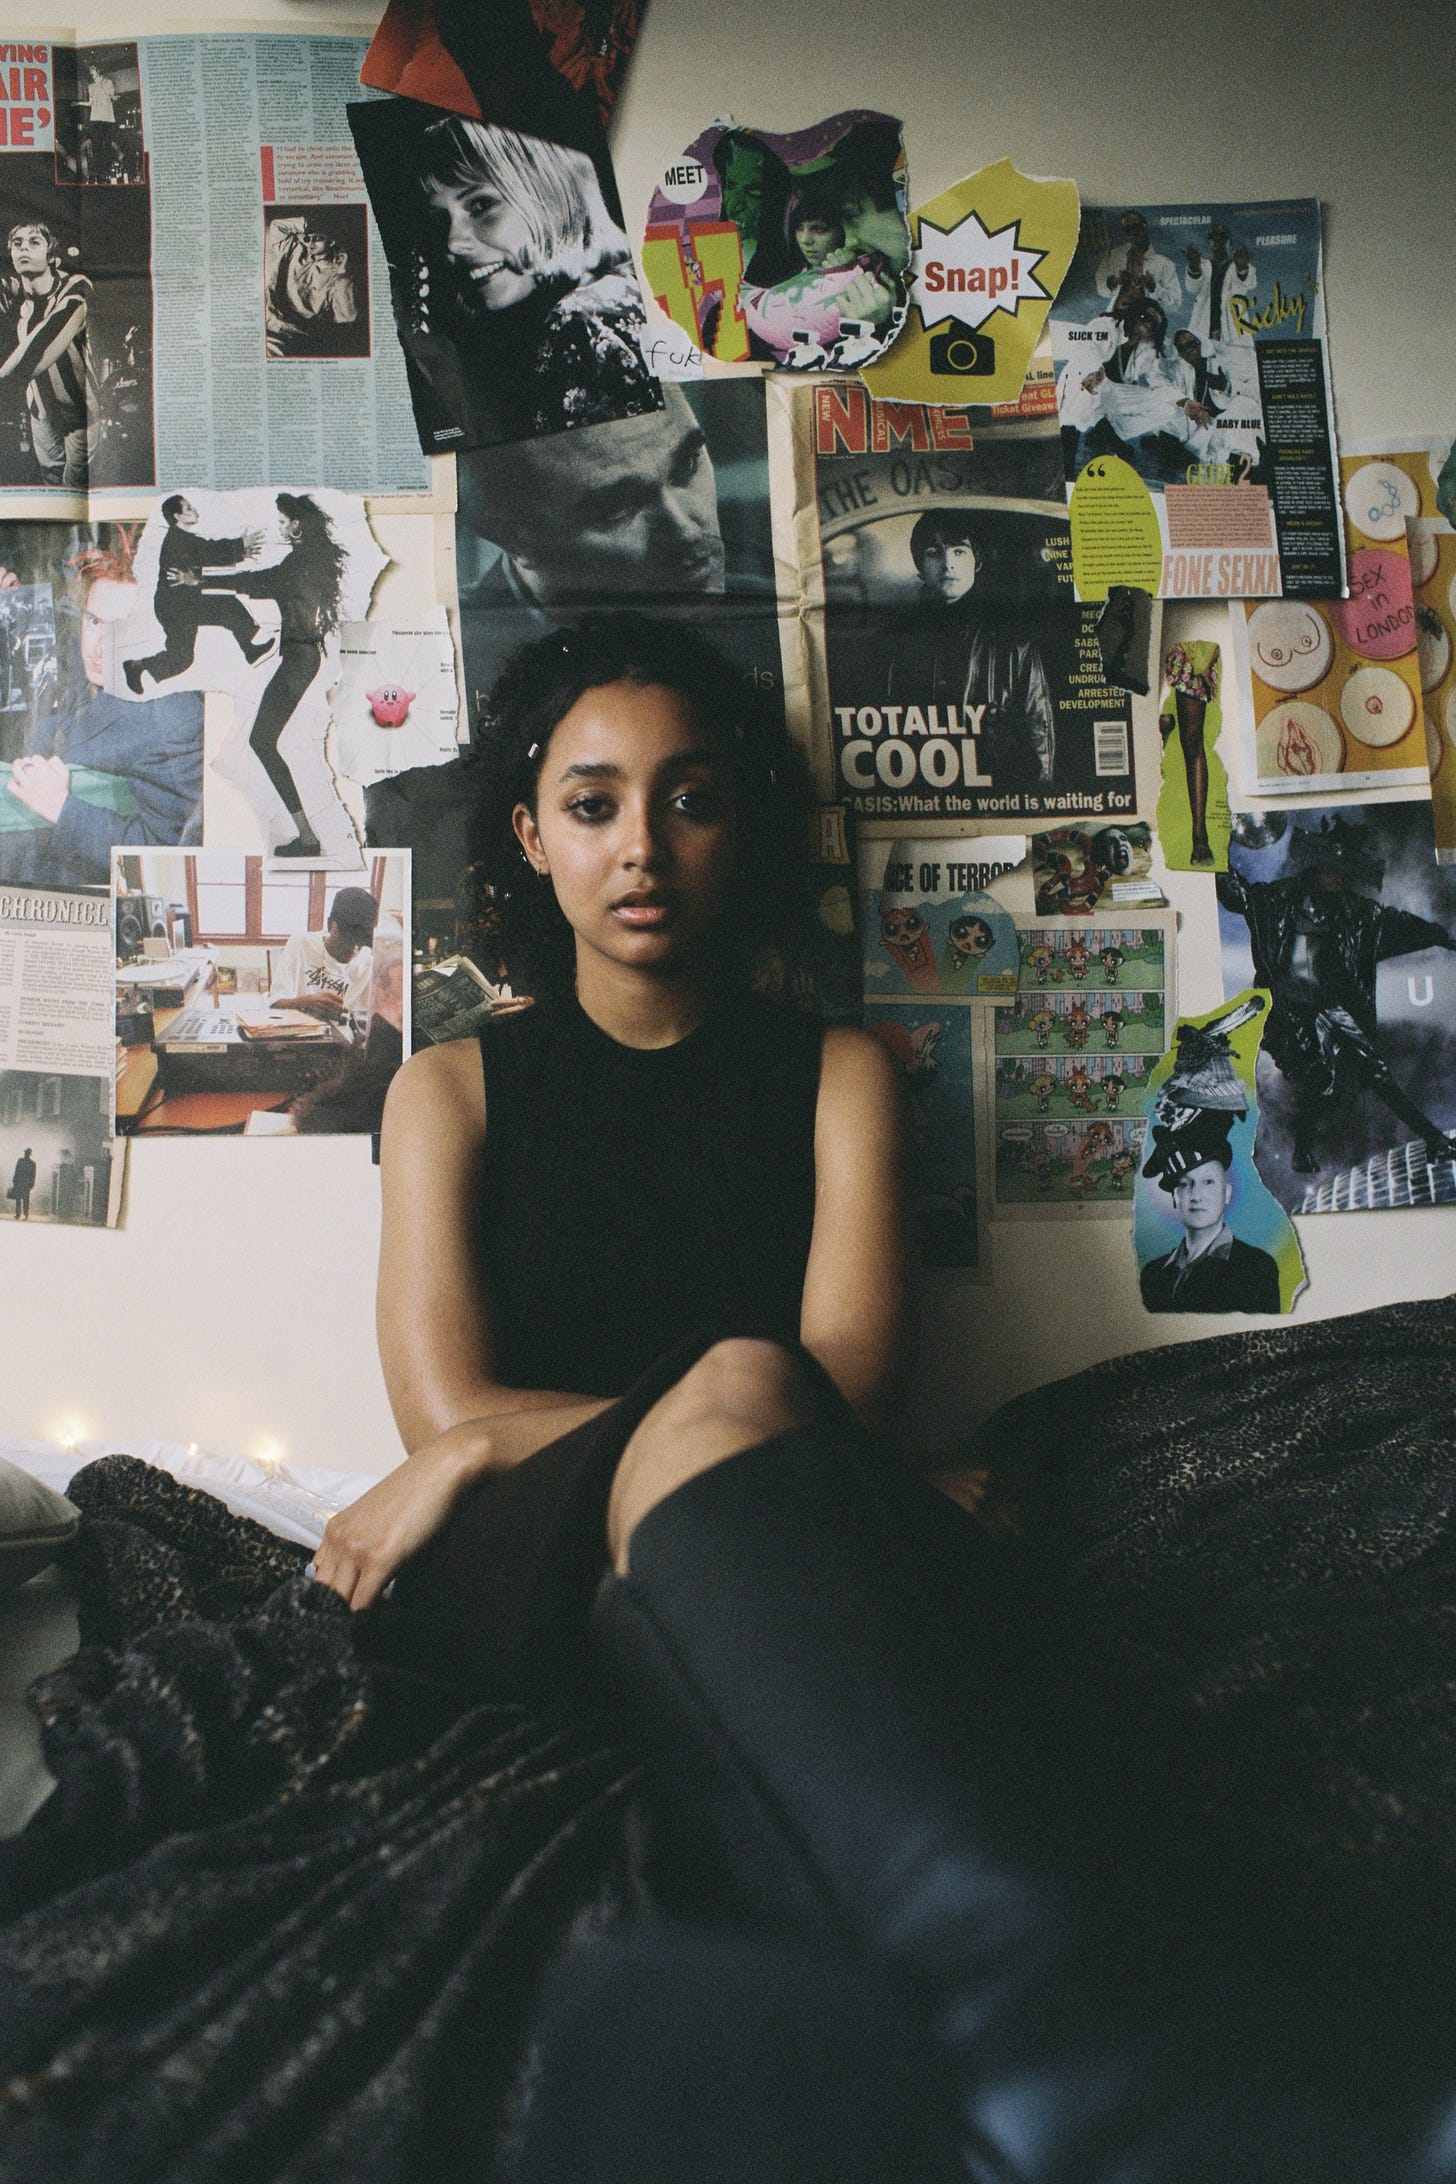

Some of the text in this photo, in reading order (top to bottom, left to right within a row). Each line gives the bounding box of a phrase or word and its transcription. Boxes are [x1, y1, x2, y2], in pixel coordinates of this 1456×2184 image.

[664, 165, 704, 186] MEET
[1160, 215, 1212, 226] SPECTACULAR
[1256, 234, 1298, 246] PLEASURE
[925, 258, 1019, 298] Snap!
[1068, 331, 1093, 341] SLICK
[992, 402, 1057, 414] Ticket Giveaw
[815, 385, 975, 454] NME
[876, 402, 886, 443] USICAL
[1216, 418, 1262, 430] BABY BLUE
[821, 455, 962, 517] THE OAS
[1045, 536, 1070, 547] LUSH
[1045, 550, 1069, 560] NINE
[1161, 554, 1213, 597] FONE
[1351, 564, 1386, 595] SEX
[1371, 593, 1390, 611] in
[1079, 649, 1102, 659] PAR
[1078, 688, 1125, 698] ARRESTED
[1059, 698, 1126, 710] DEVELOPMENT
[835, 704, 987, 736] TOTALLY
[840, 738, 993, 789] COOL
[946, 794, 972, 811] the
[976, 794, 1020, 812] world
[1024, 794, 1040, 811] is
[1043, 792, 1103, 812] waiting
[1107, 791, 1132, 809] for
[919, 862, 941, 893] OF
[1407, 975, 1434, 1007] U
